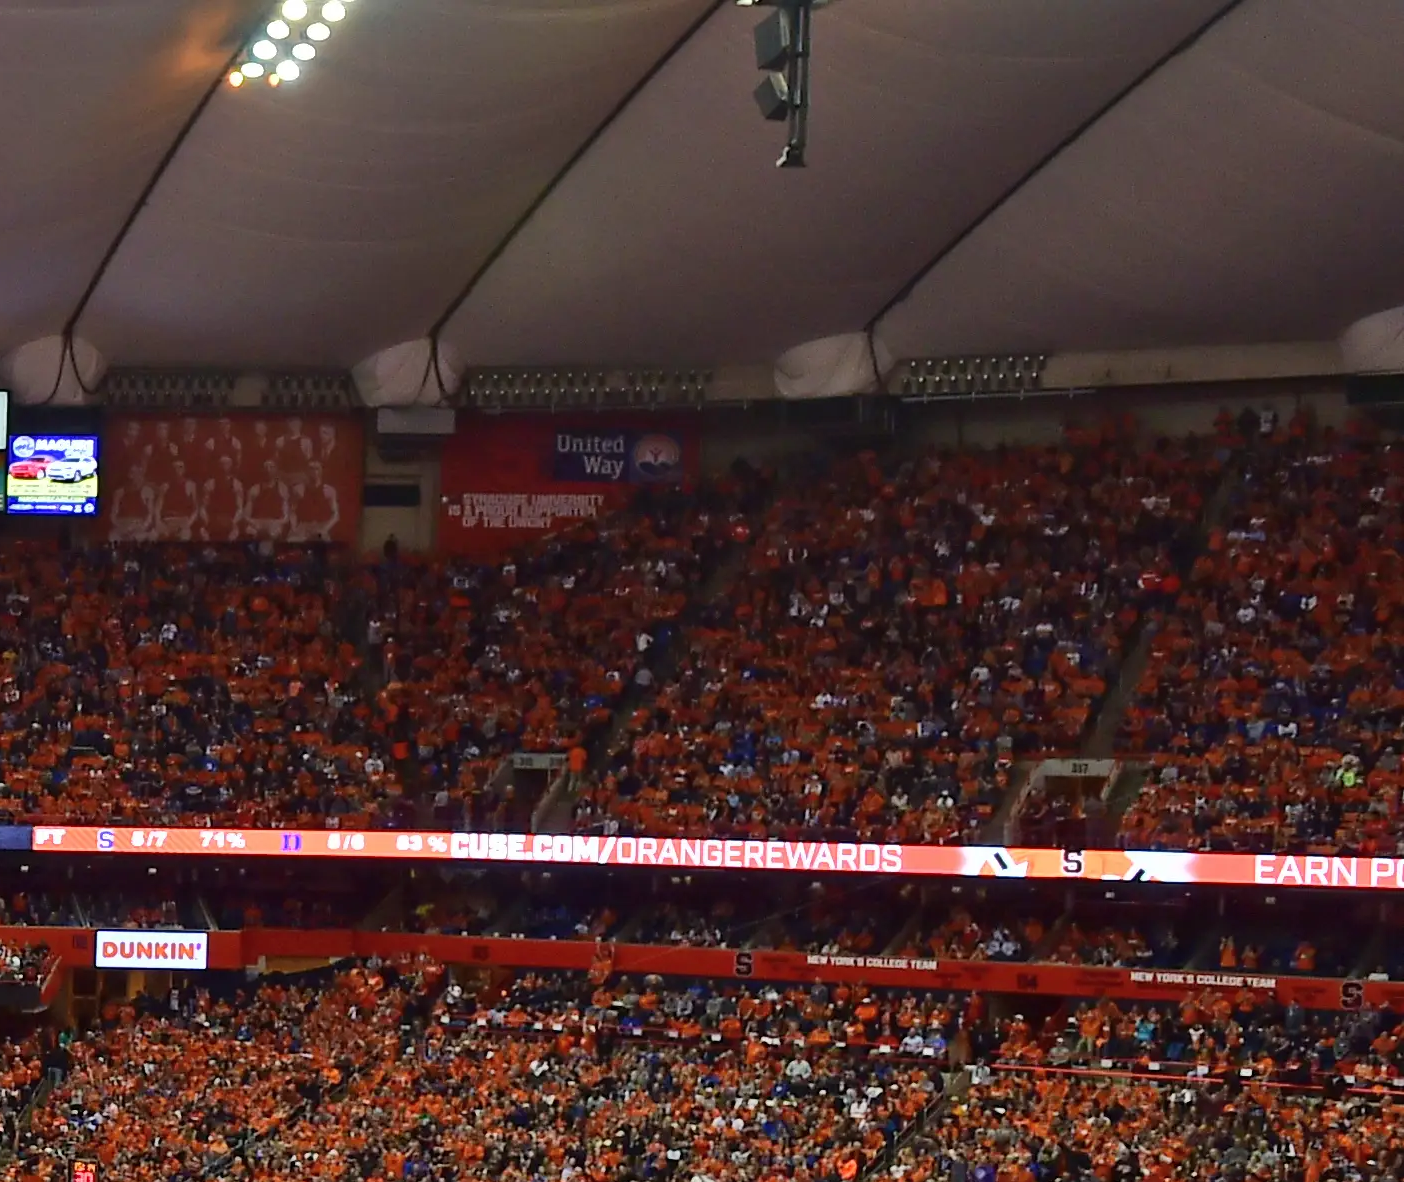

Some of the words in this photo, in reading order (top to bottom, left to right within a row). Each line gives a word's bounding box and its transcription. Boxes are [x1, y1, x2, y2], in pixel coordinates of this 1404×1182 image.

[556, 433, 624, 455] United
[584, 455, 624, 479] Way
[96, 830, 114, 849] S
[199, 832, 245, 849] 71%
[427, 837, 447, 852] %
[451, 833, 902, 873] CUSE.COM/ORANGEREWARDS
[1255, 855, 1357, 886] EARN
[102, 941, 201, 961] DUNKIN'
[807, 954, 827, 965] NEW
[866, 957, 907, 969] COLLEGE
[910, 958, 937, 970] TEAM
[1130, 971, 1154, 984] NEW
[1197, 974, 1243, 987] COLLEGE
[1247, 976, 1276, 989] TEAM
